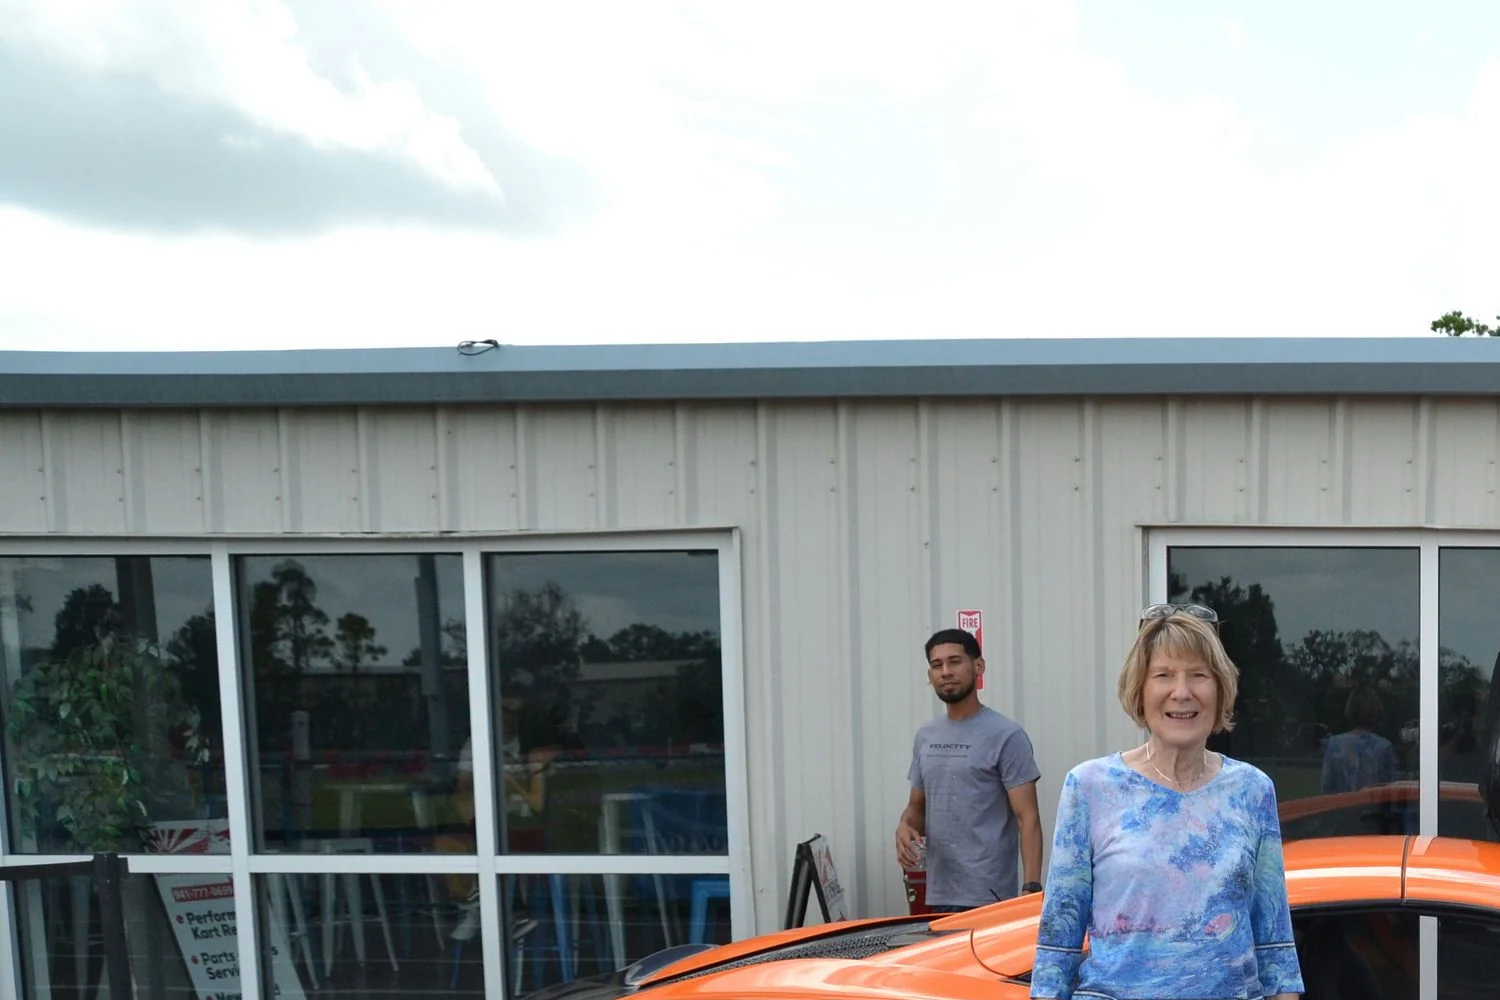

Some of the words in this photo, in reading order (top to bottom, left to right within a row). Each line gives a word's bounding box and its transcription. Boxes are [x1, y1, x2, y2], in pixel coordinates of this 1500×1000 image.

[962, 617, 978, 628] FIRE
[185, 910, 236, 925] Perform
[191, 927, 221, 940] Kart
[200, 952, 236, 965] Parts
[206, 967, 240, 980] Servi
